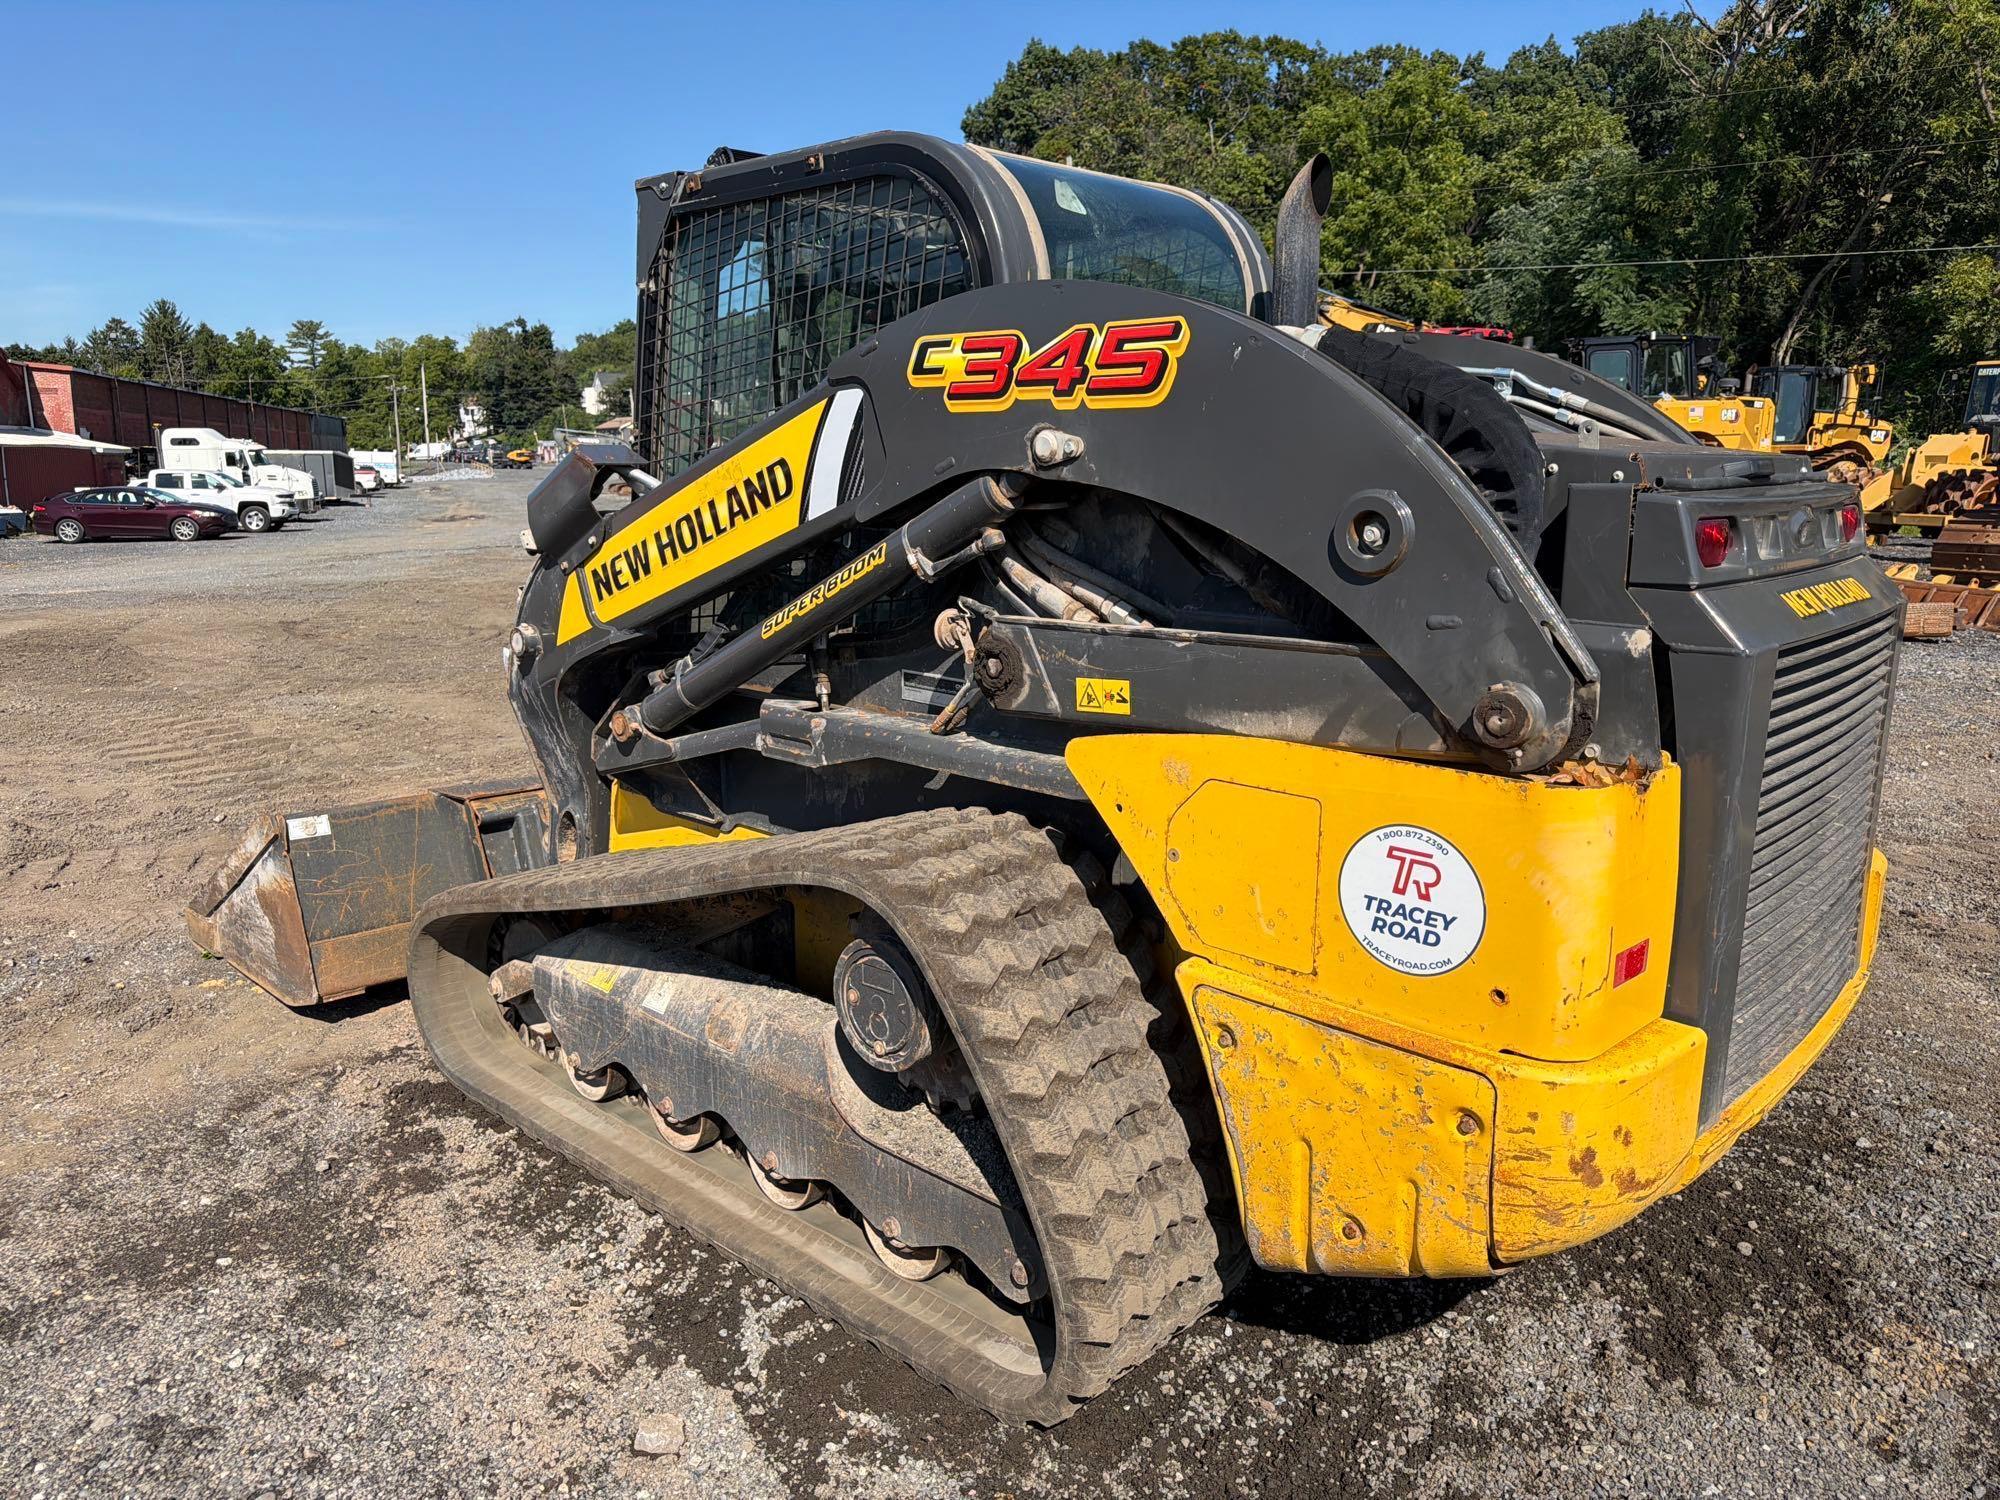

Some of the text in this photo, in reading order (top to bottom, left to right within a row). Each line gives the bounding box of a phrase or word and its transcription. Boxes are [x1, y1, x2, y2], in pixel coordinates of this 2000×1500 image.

[910, 321, 1184, 402] C345
[1721, 409, 1737, 421] CAT
[1870, 429, 1886, 442] CAT
[591, 456, 794, 602] NEW HOLLAND
[762, 542, 886, 639] SUPER BOOM
[1780, 577, 1873, 618] NEW HOLLAND
[1376, 829, 1450, 857] 1.800.872.2390
[1363, 894, 1458, 932] TRACEY
[1371, 915, 1441, 948] ROAD
[1362, 935, 1453, 972] TRACEYROAD.COM
